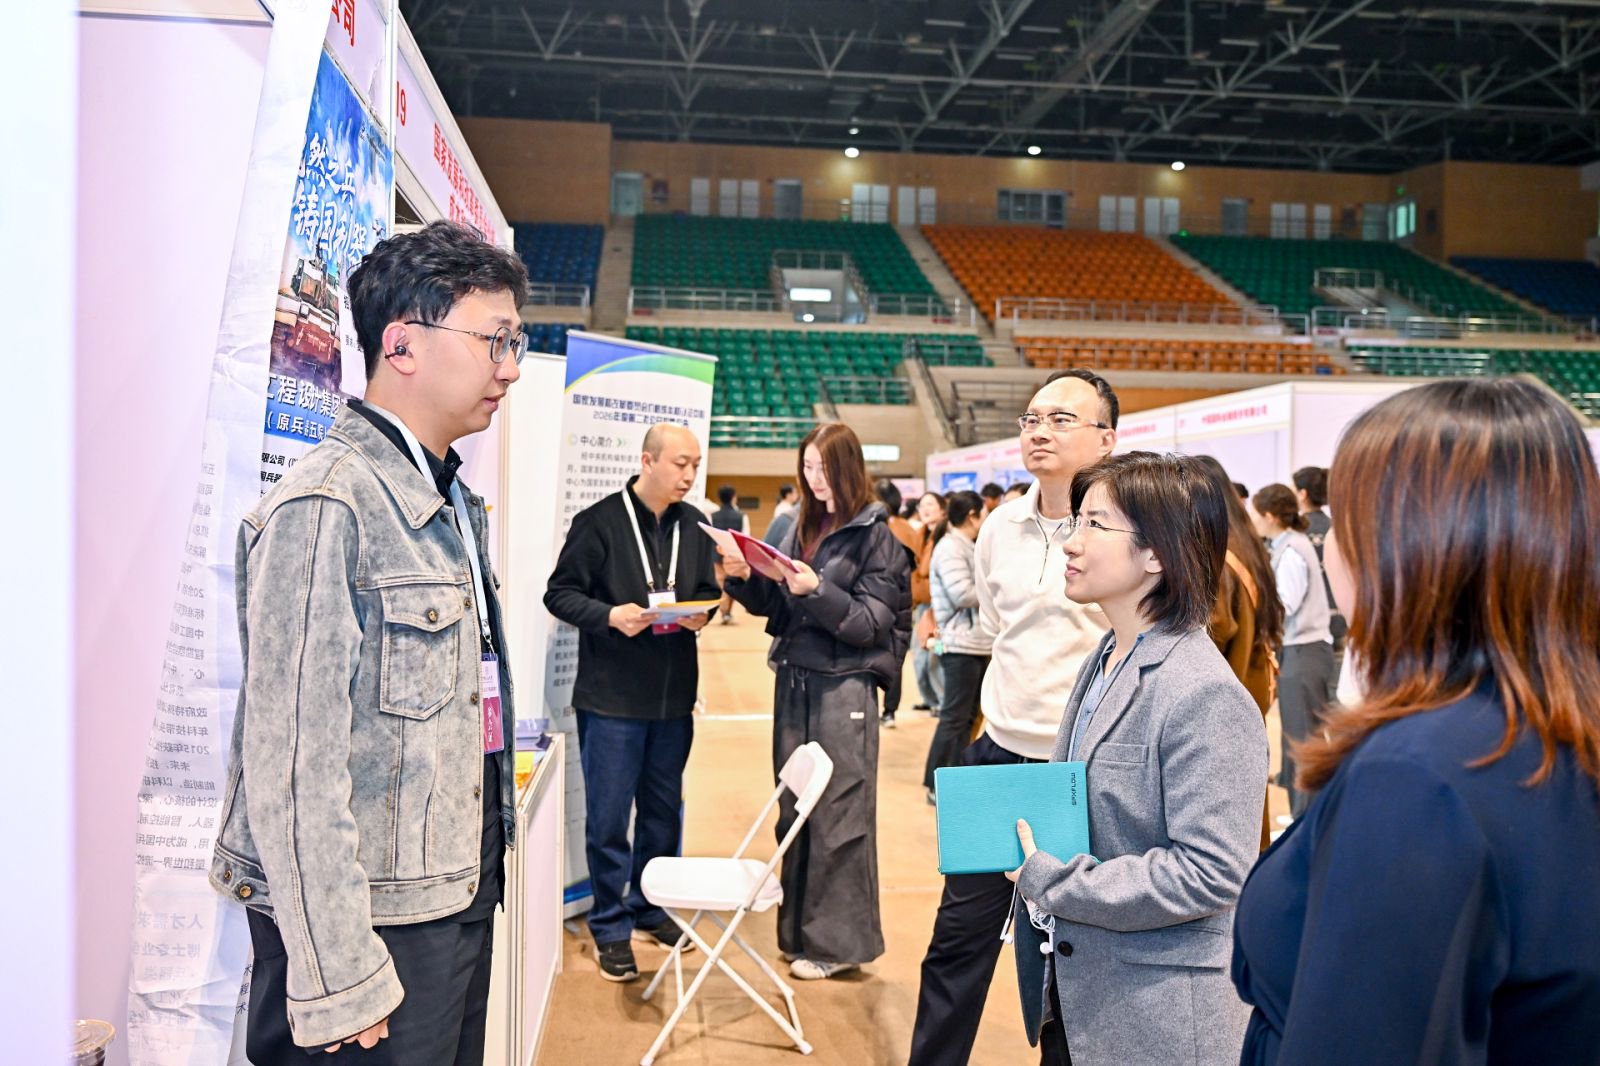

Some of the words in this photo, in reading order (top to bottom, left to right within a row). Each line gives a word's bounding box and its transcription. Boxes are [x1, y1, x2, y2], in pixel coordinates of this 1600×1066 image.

[266, 373, 348, 419] 工程设计集团
